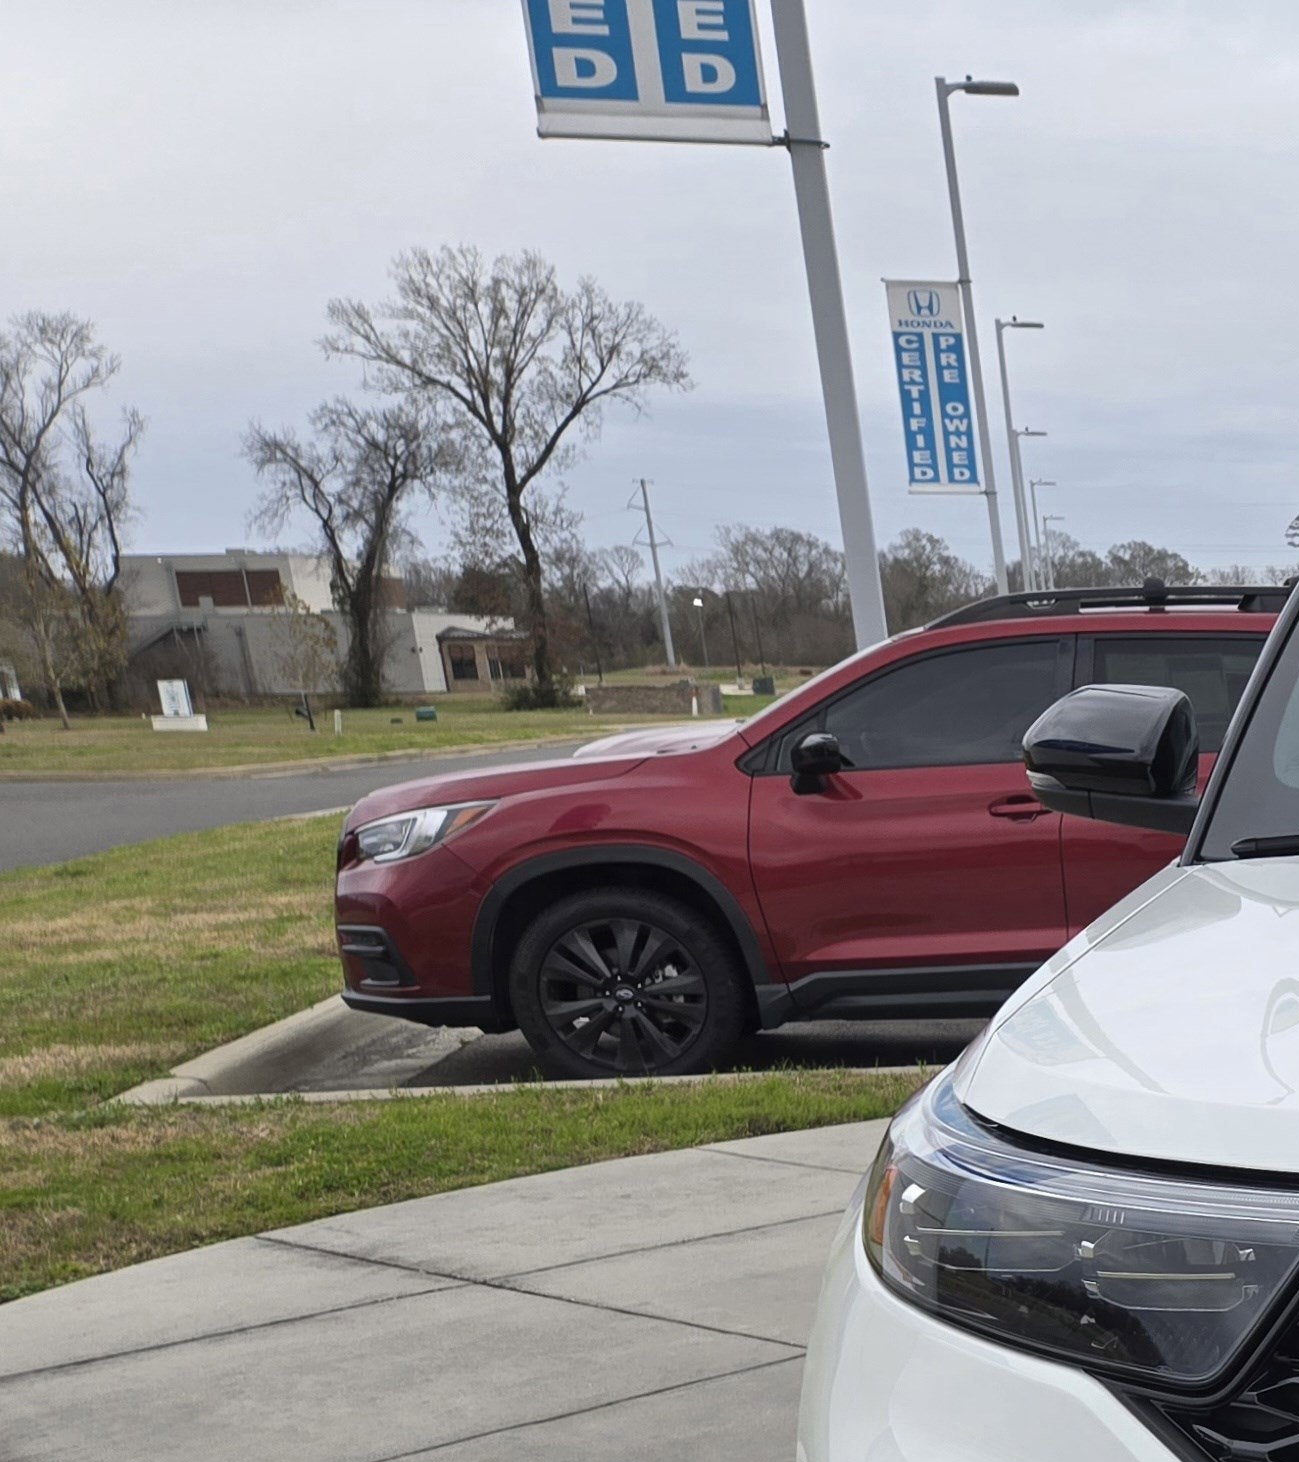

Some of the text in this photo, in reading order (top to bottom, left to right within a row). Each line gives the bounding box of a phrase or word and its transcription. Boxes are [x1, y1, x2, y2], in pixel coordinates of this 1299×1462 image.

[898, 319, 955, 330] HONDA
[898, 335, 935, 481] CERTIFIED
[938, 335, 971, 481] PRE OWNED
